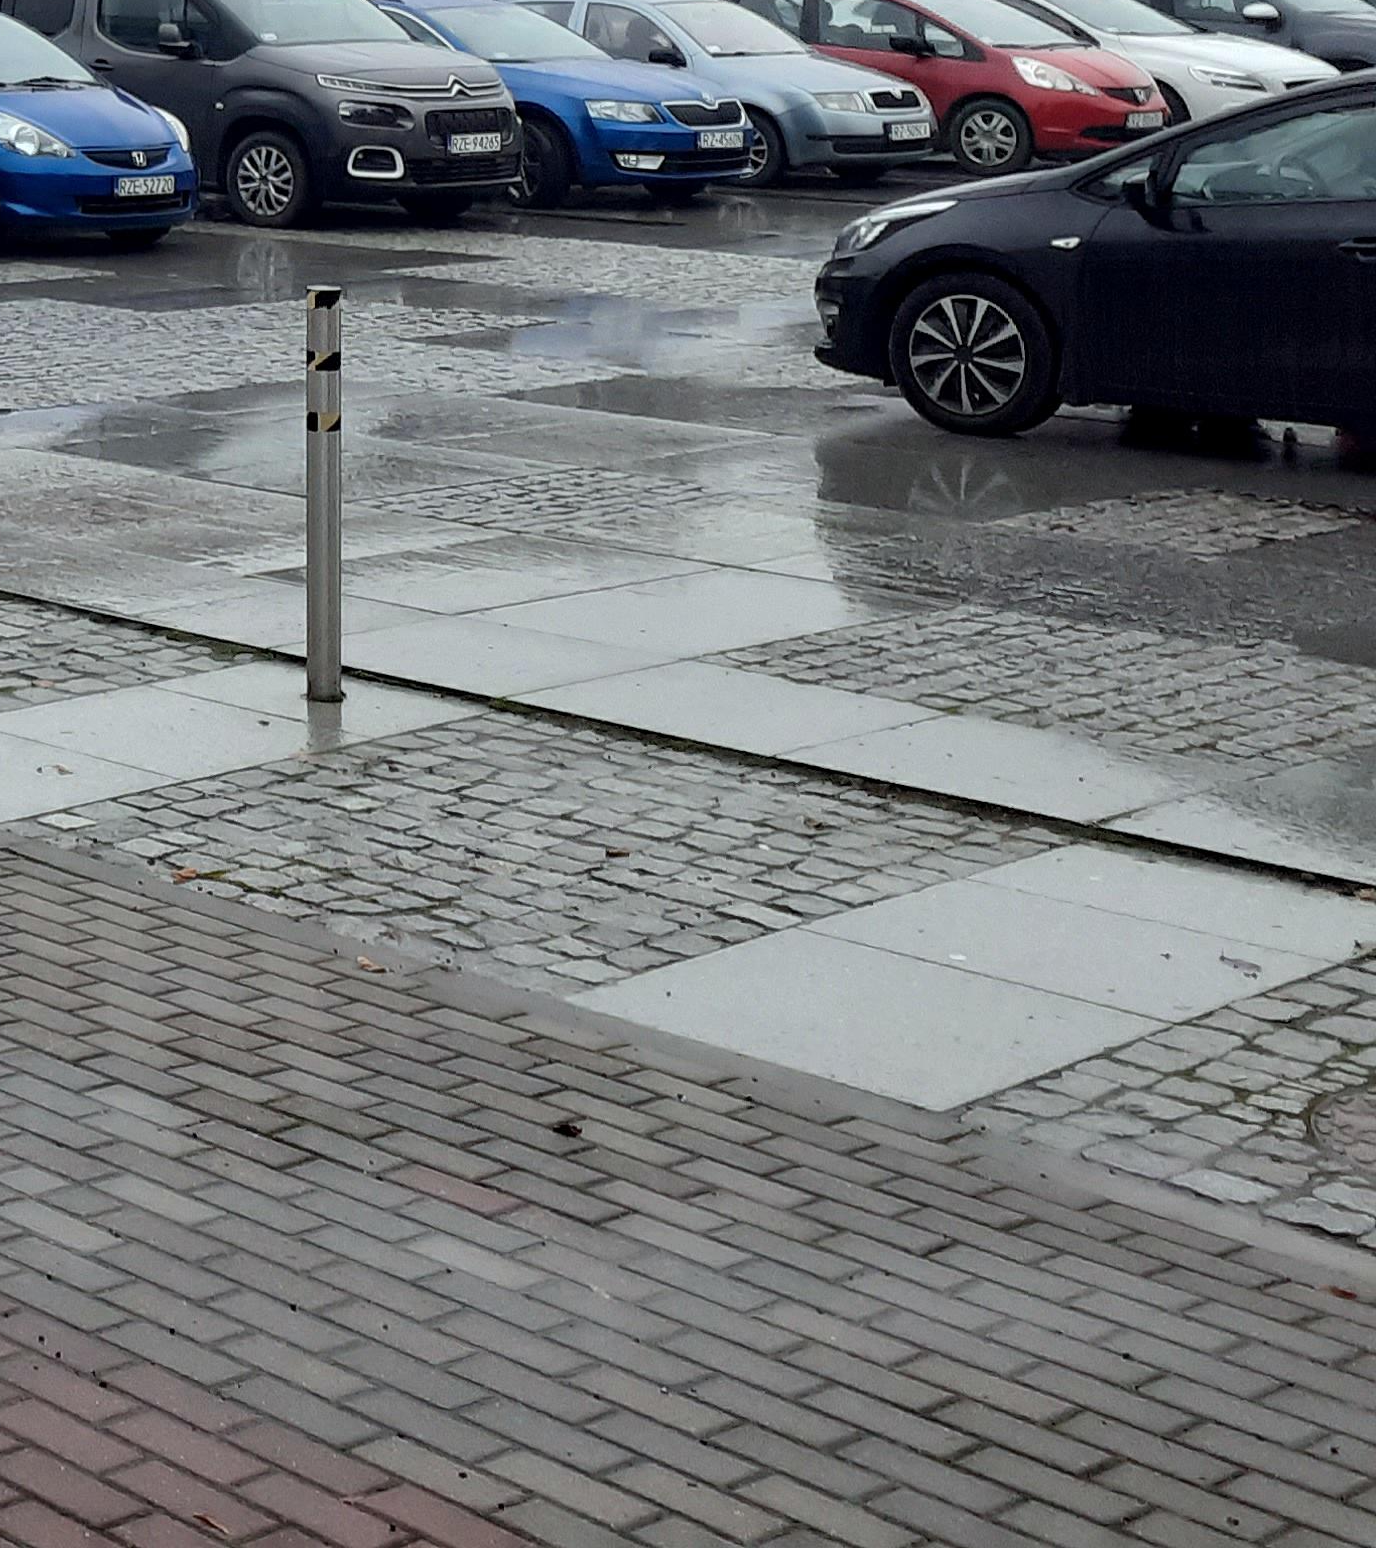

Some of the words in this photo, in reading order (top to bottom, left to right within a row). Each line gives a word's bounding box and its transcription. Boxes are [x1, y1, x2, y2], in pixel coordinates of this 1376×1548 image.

[453, 137, 470, 151] RZE
[120, 179, 140, 195] RZE
[144, 177, 173, 194] 52720
